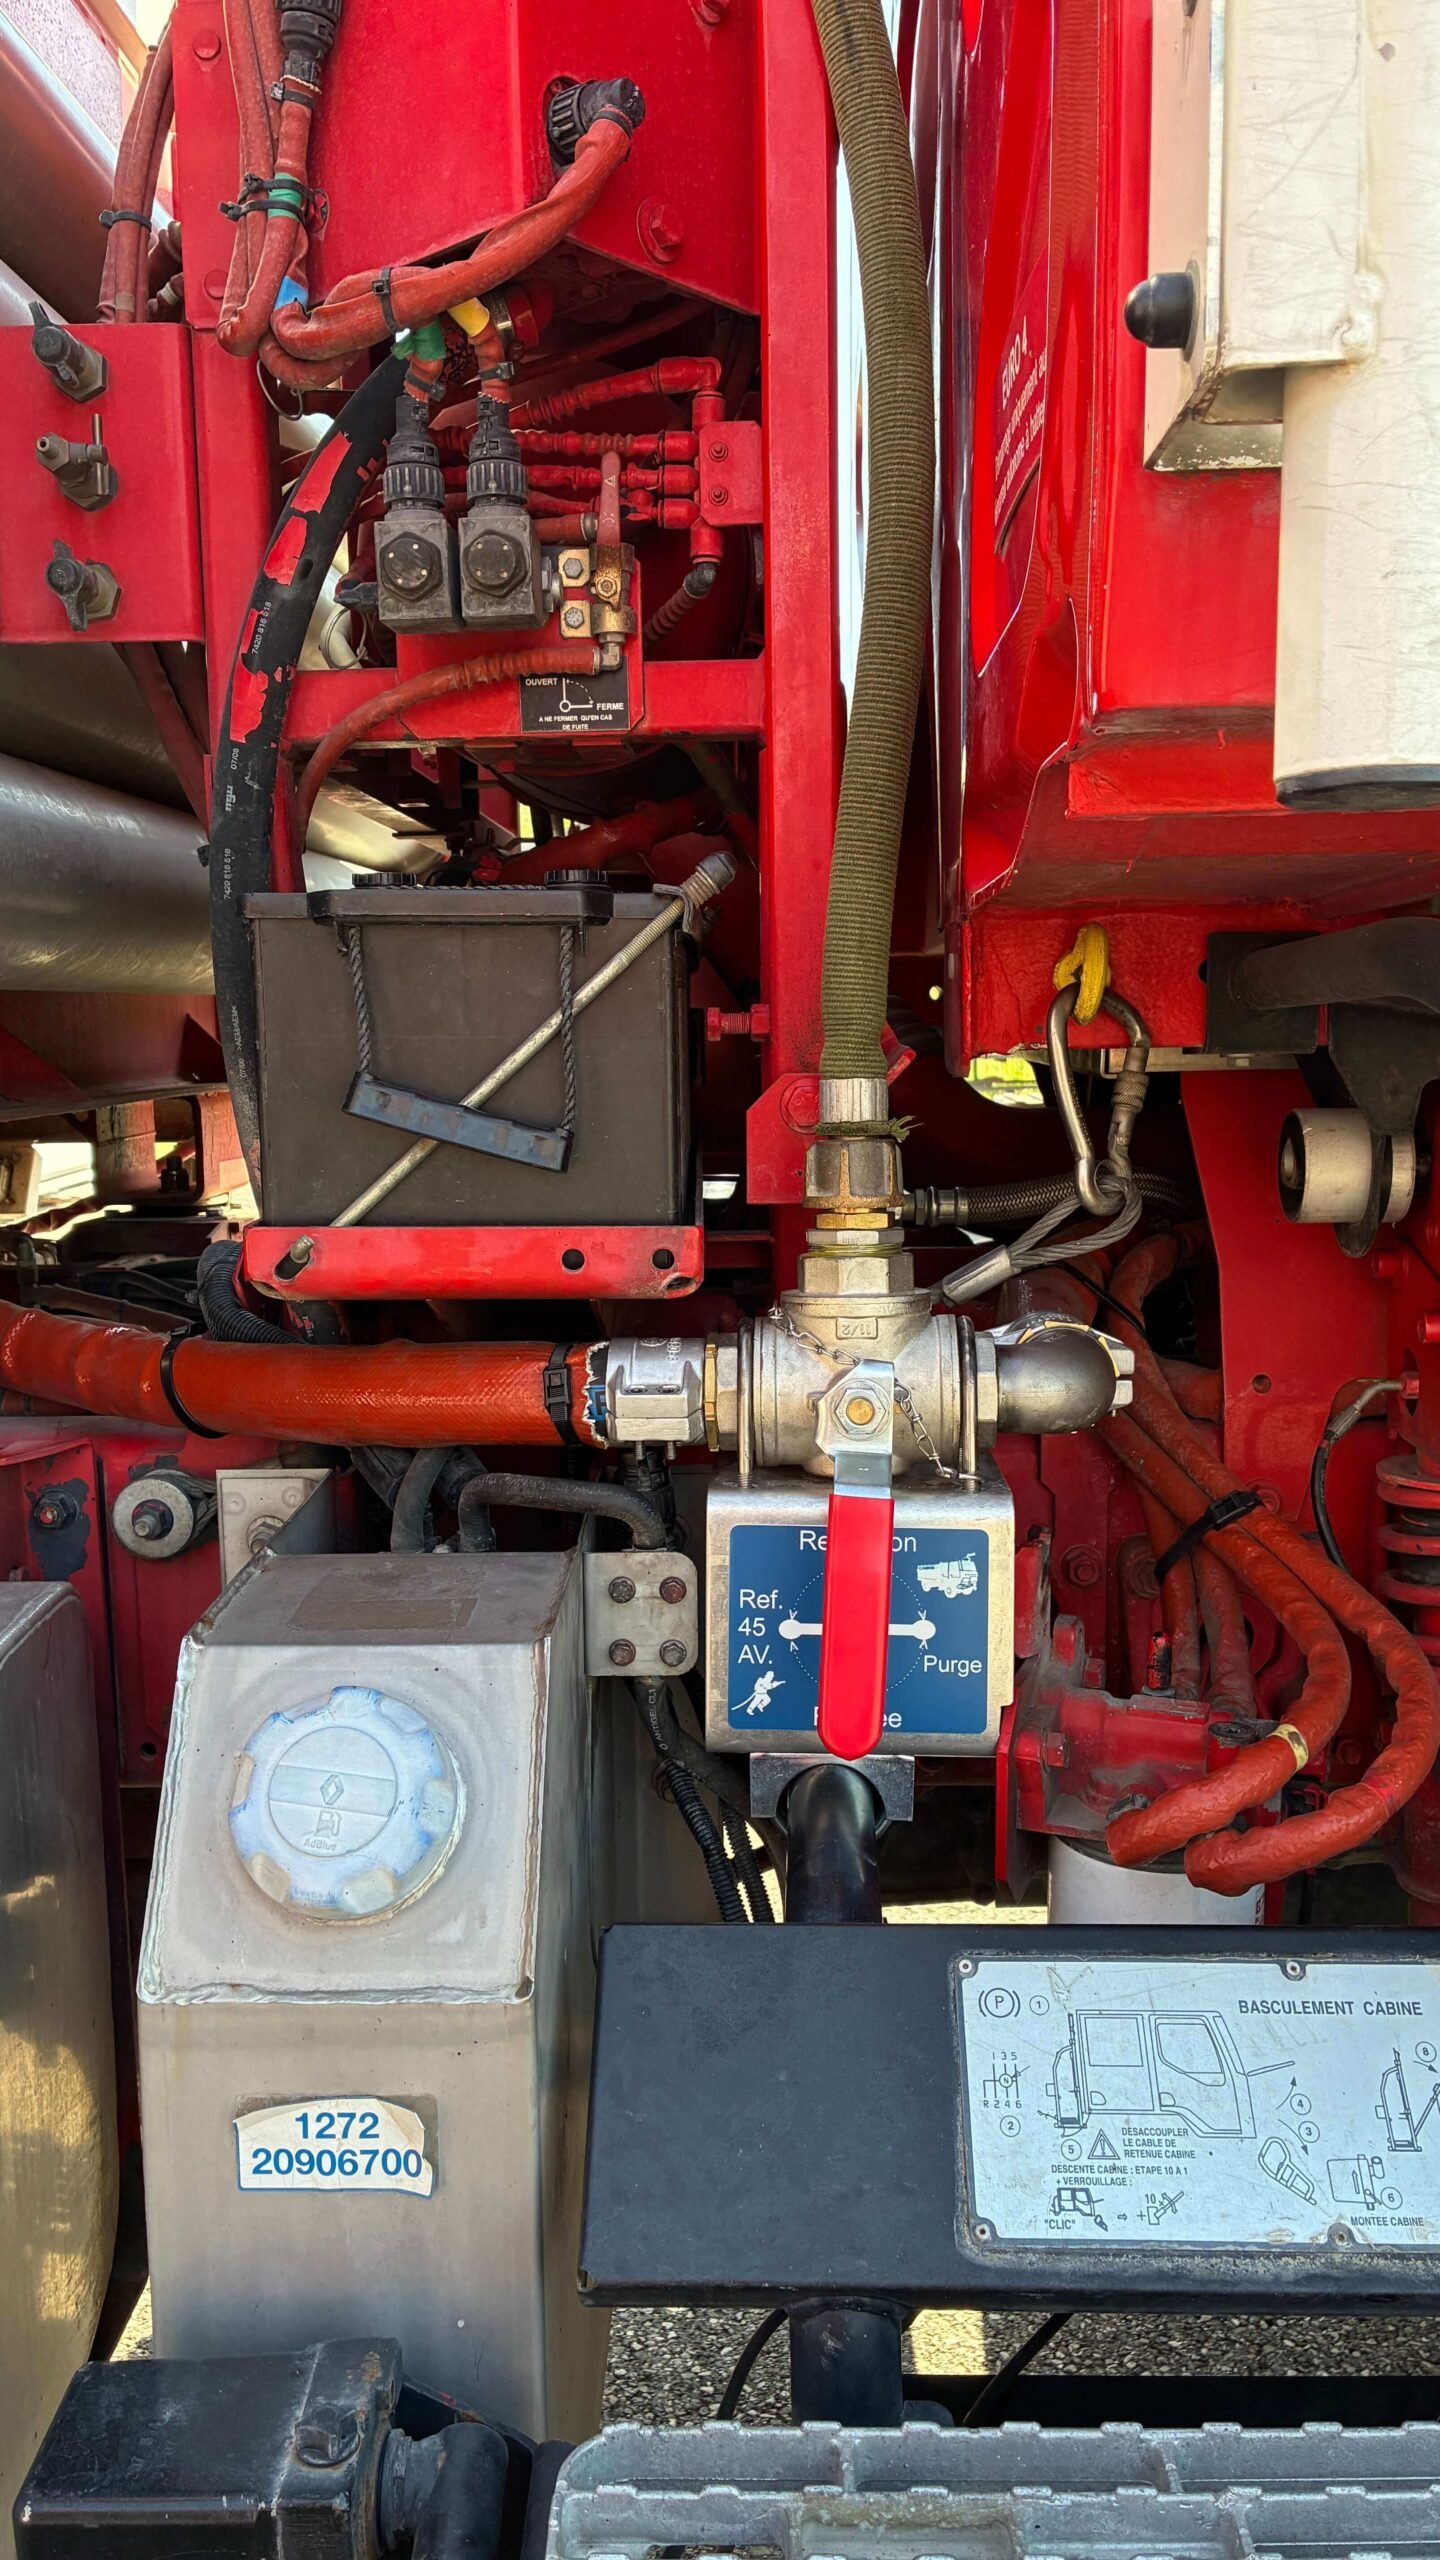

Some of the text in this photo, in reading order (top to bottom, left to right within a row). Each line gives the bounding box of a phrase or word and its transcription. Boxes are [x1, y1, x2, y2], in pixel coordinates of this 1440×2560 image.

[1003, 332, 1020, 411] EURO
[1022, 315, 1028, 355] 4
[525, 678, 558, 686] OUVERT
[597, 703, 624, 711] FERME
[740, 1589, 783, 1609] Ref.
[738, 1617, 766, 1637] 45
[738, 1644, 773, 1665] AV.
[923, 1655, 982, 1677] Purge
[304, 1837, 337, 1851] AdBlue
[1238, 2000, 1423, 2016] BASCULEMENT CABINE
[1001, 2051, 1007, 2061] 3
[1011, 2051, 1018, 2061] 5
[983, 2100, 1022, 2109] R 2 4 6
[295, 2112, 380, 2140] 1272
[1121, 2127, 1189, 2137] DESACCOUPLER
[1122, 2138, 1177, 2148] LE CABLE DE
[1124, 2149, 1196, 2159] RETENUE CABINE
[252, 2148, 423, 2178] 20906700
[1051, 2164, 1096, 2174] DESCENTE
[1097, 2165, 1128, 2174] CABINE
[1135, 2166, 1163, 2174] ETAPE
[1164, 2166, 1174, 2175] 10
[1063, 2176, 1128, 2186] VERROUILLAGE
[1144, 2193, 1157, 2204] 10
[1044, 2219, 1076, 2230] "CLIC"
[1350, 2216, 1425, 2227] MONTEE CABINE
